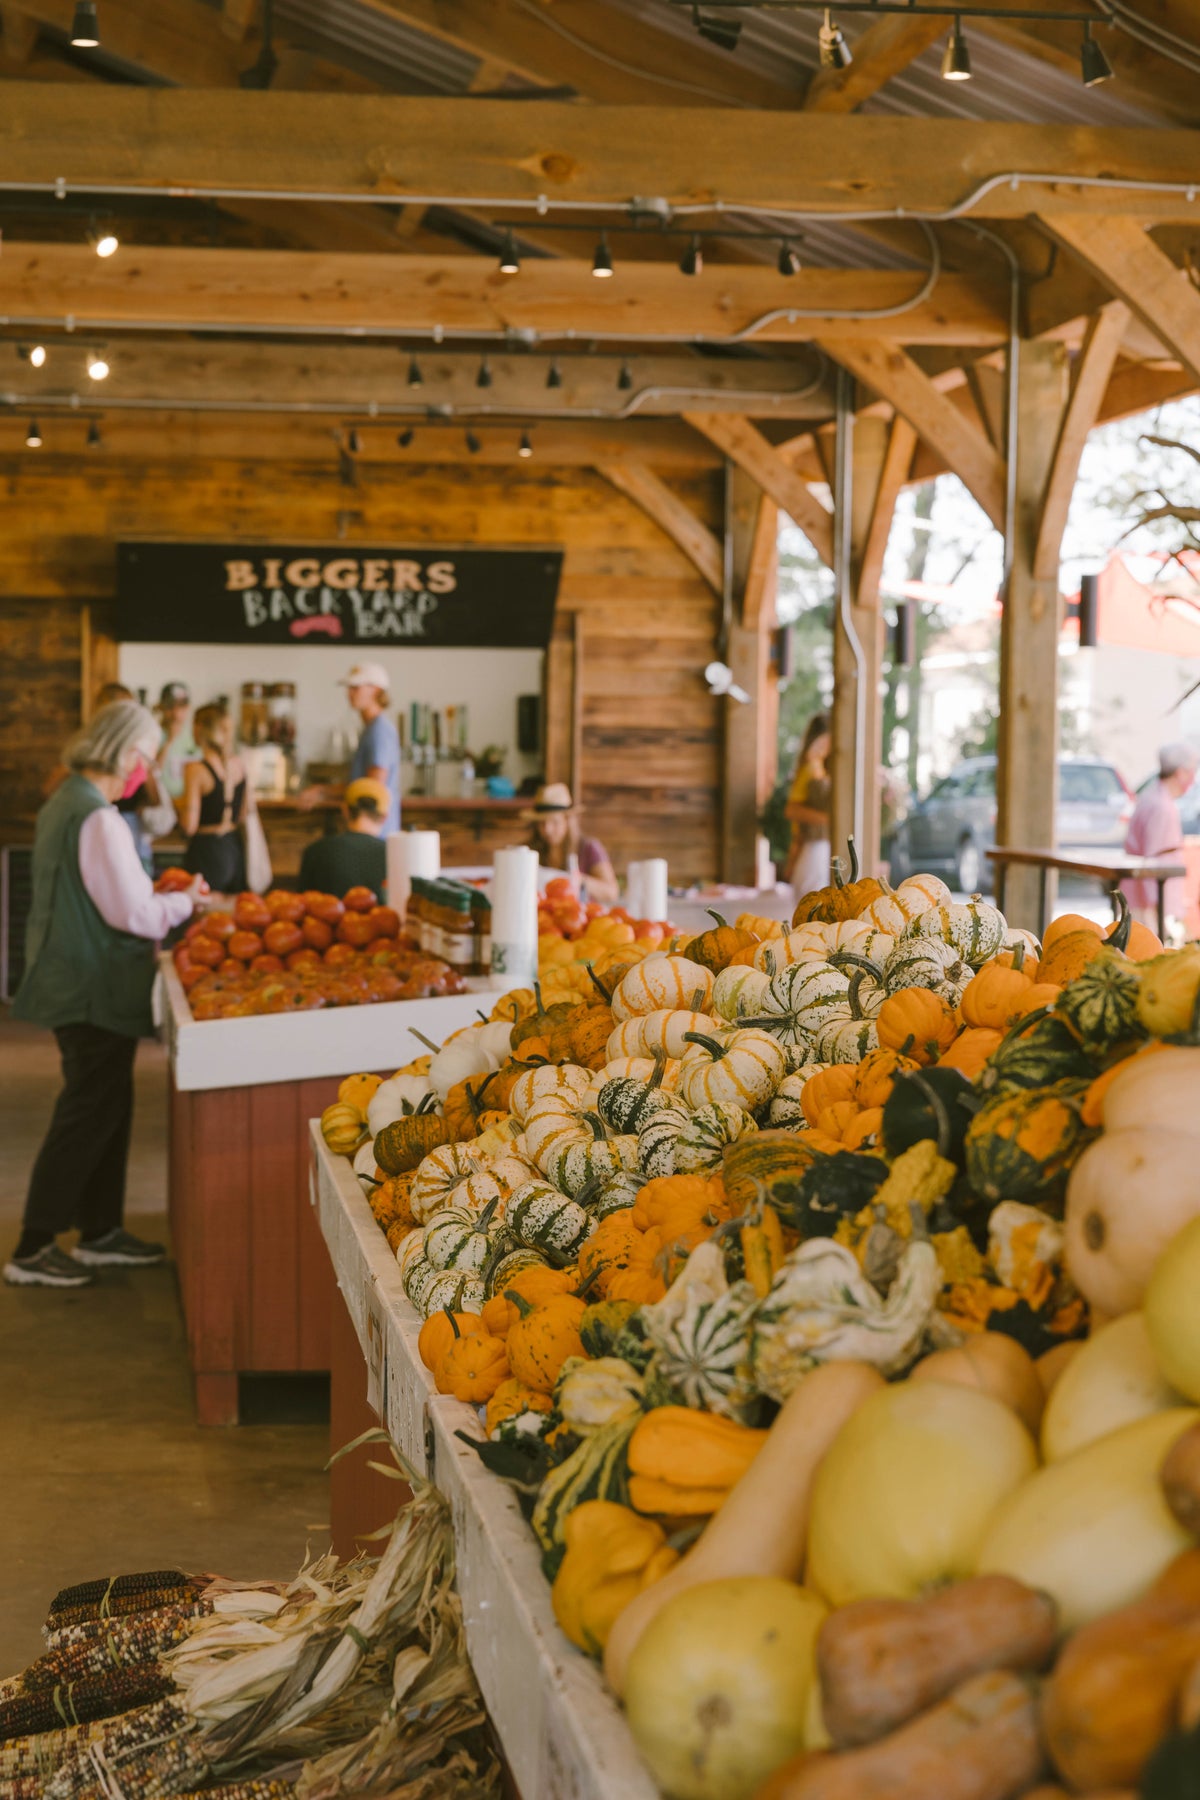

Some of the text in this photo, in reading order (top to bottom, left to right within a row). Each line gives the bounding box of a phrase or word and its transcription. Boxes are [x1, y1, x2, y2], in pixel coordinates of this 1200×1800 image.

[225, 559, 457, 593] BIGGERS
[242, 588, 438, 627] BACKYARD
[355, 608, 425, 638] BAR
